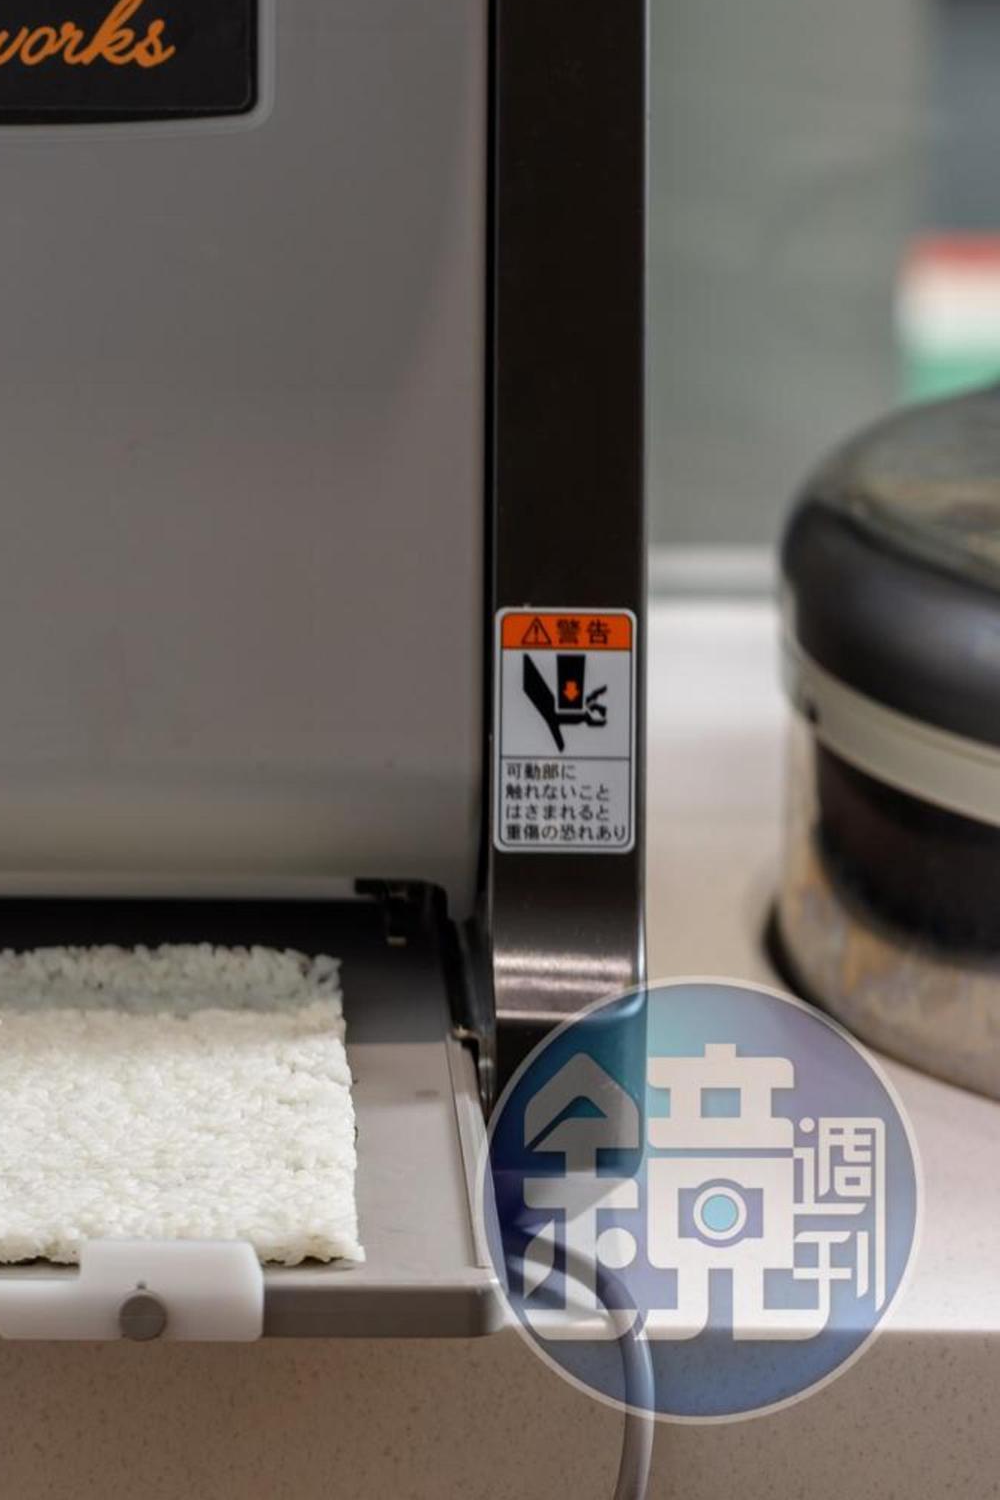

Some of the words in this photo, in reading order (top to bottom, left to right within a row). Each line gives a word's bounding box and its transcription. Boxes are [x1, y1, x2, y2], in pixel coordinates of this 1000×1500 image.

[556, 618, 612, 645] 警告
[506, 762, 577, 781] 可動部に
[505, 783, 610, 801] 触れないこと
[506, 803, 610, 821] はさまれると
[505, 824, 626, 842] 重傷の恐れあり
